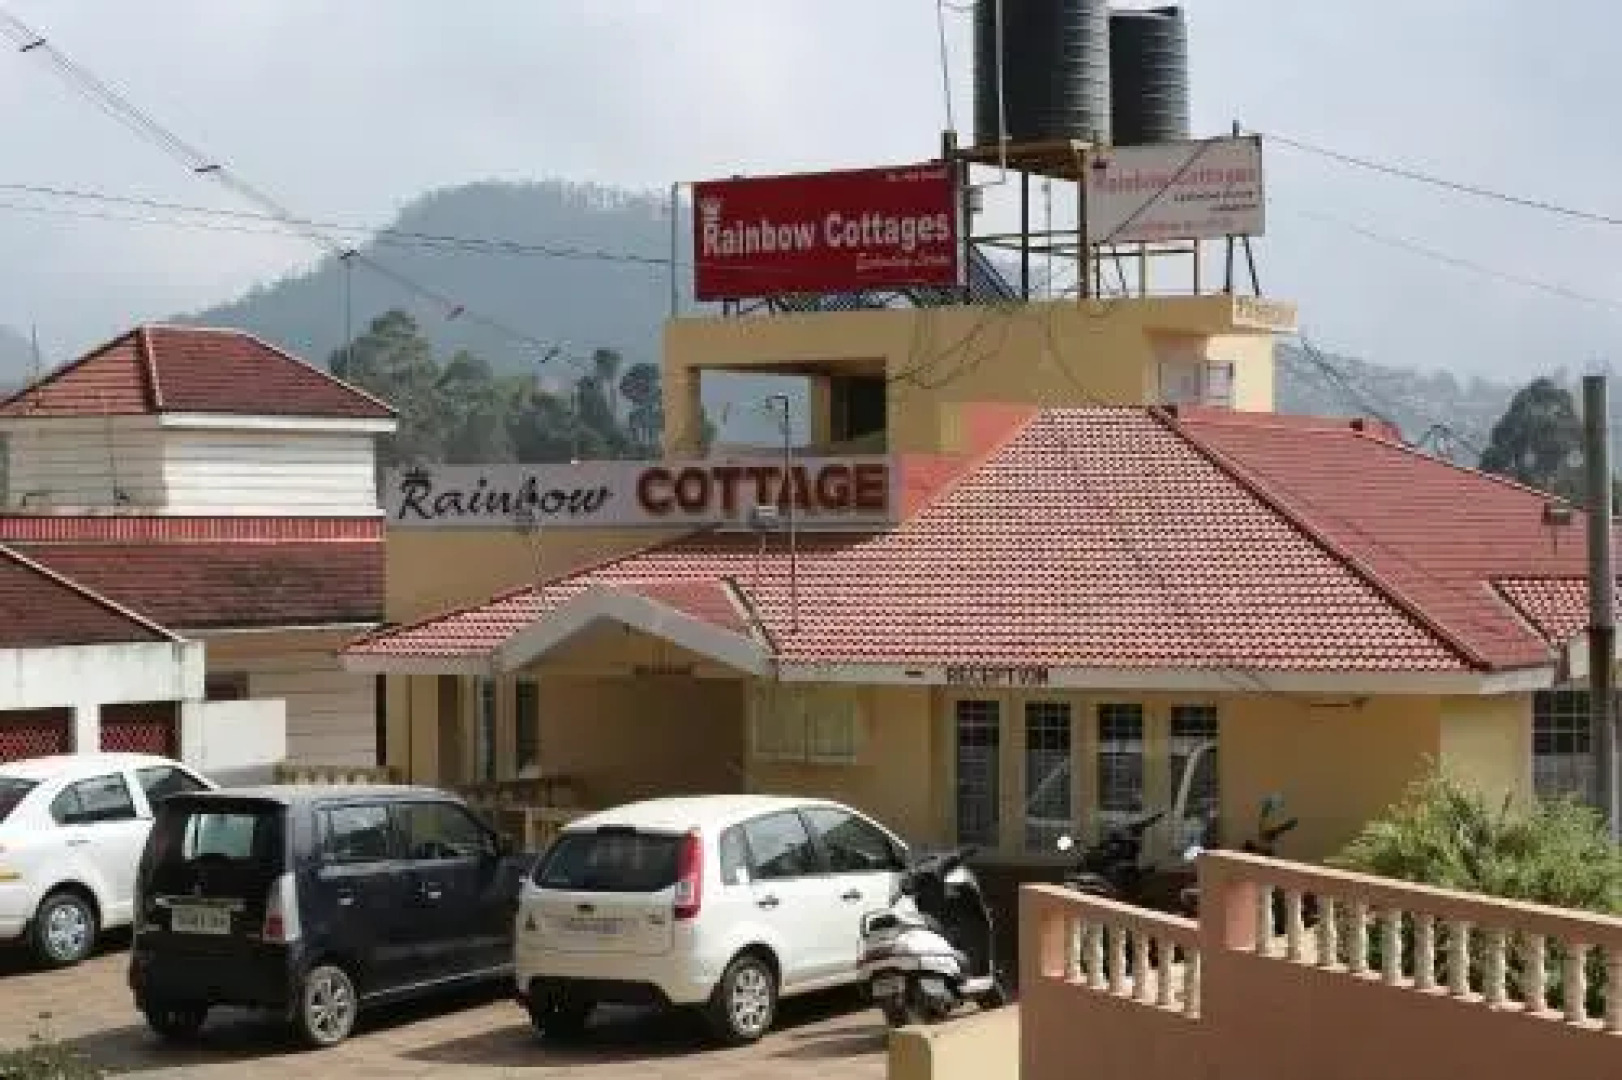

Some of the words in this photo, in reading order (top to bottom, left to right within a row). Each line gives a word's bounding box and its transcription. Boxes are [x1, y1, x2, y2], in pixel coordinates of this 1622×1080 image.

[703, 219, 815, 257] Rainbow
[824, 210, 949, 251] Cottages
[398, 475, 615, 520] Rainbow
[635, 464, 889, 515] COTTAGE
